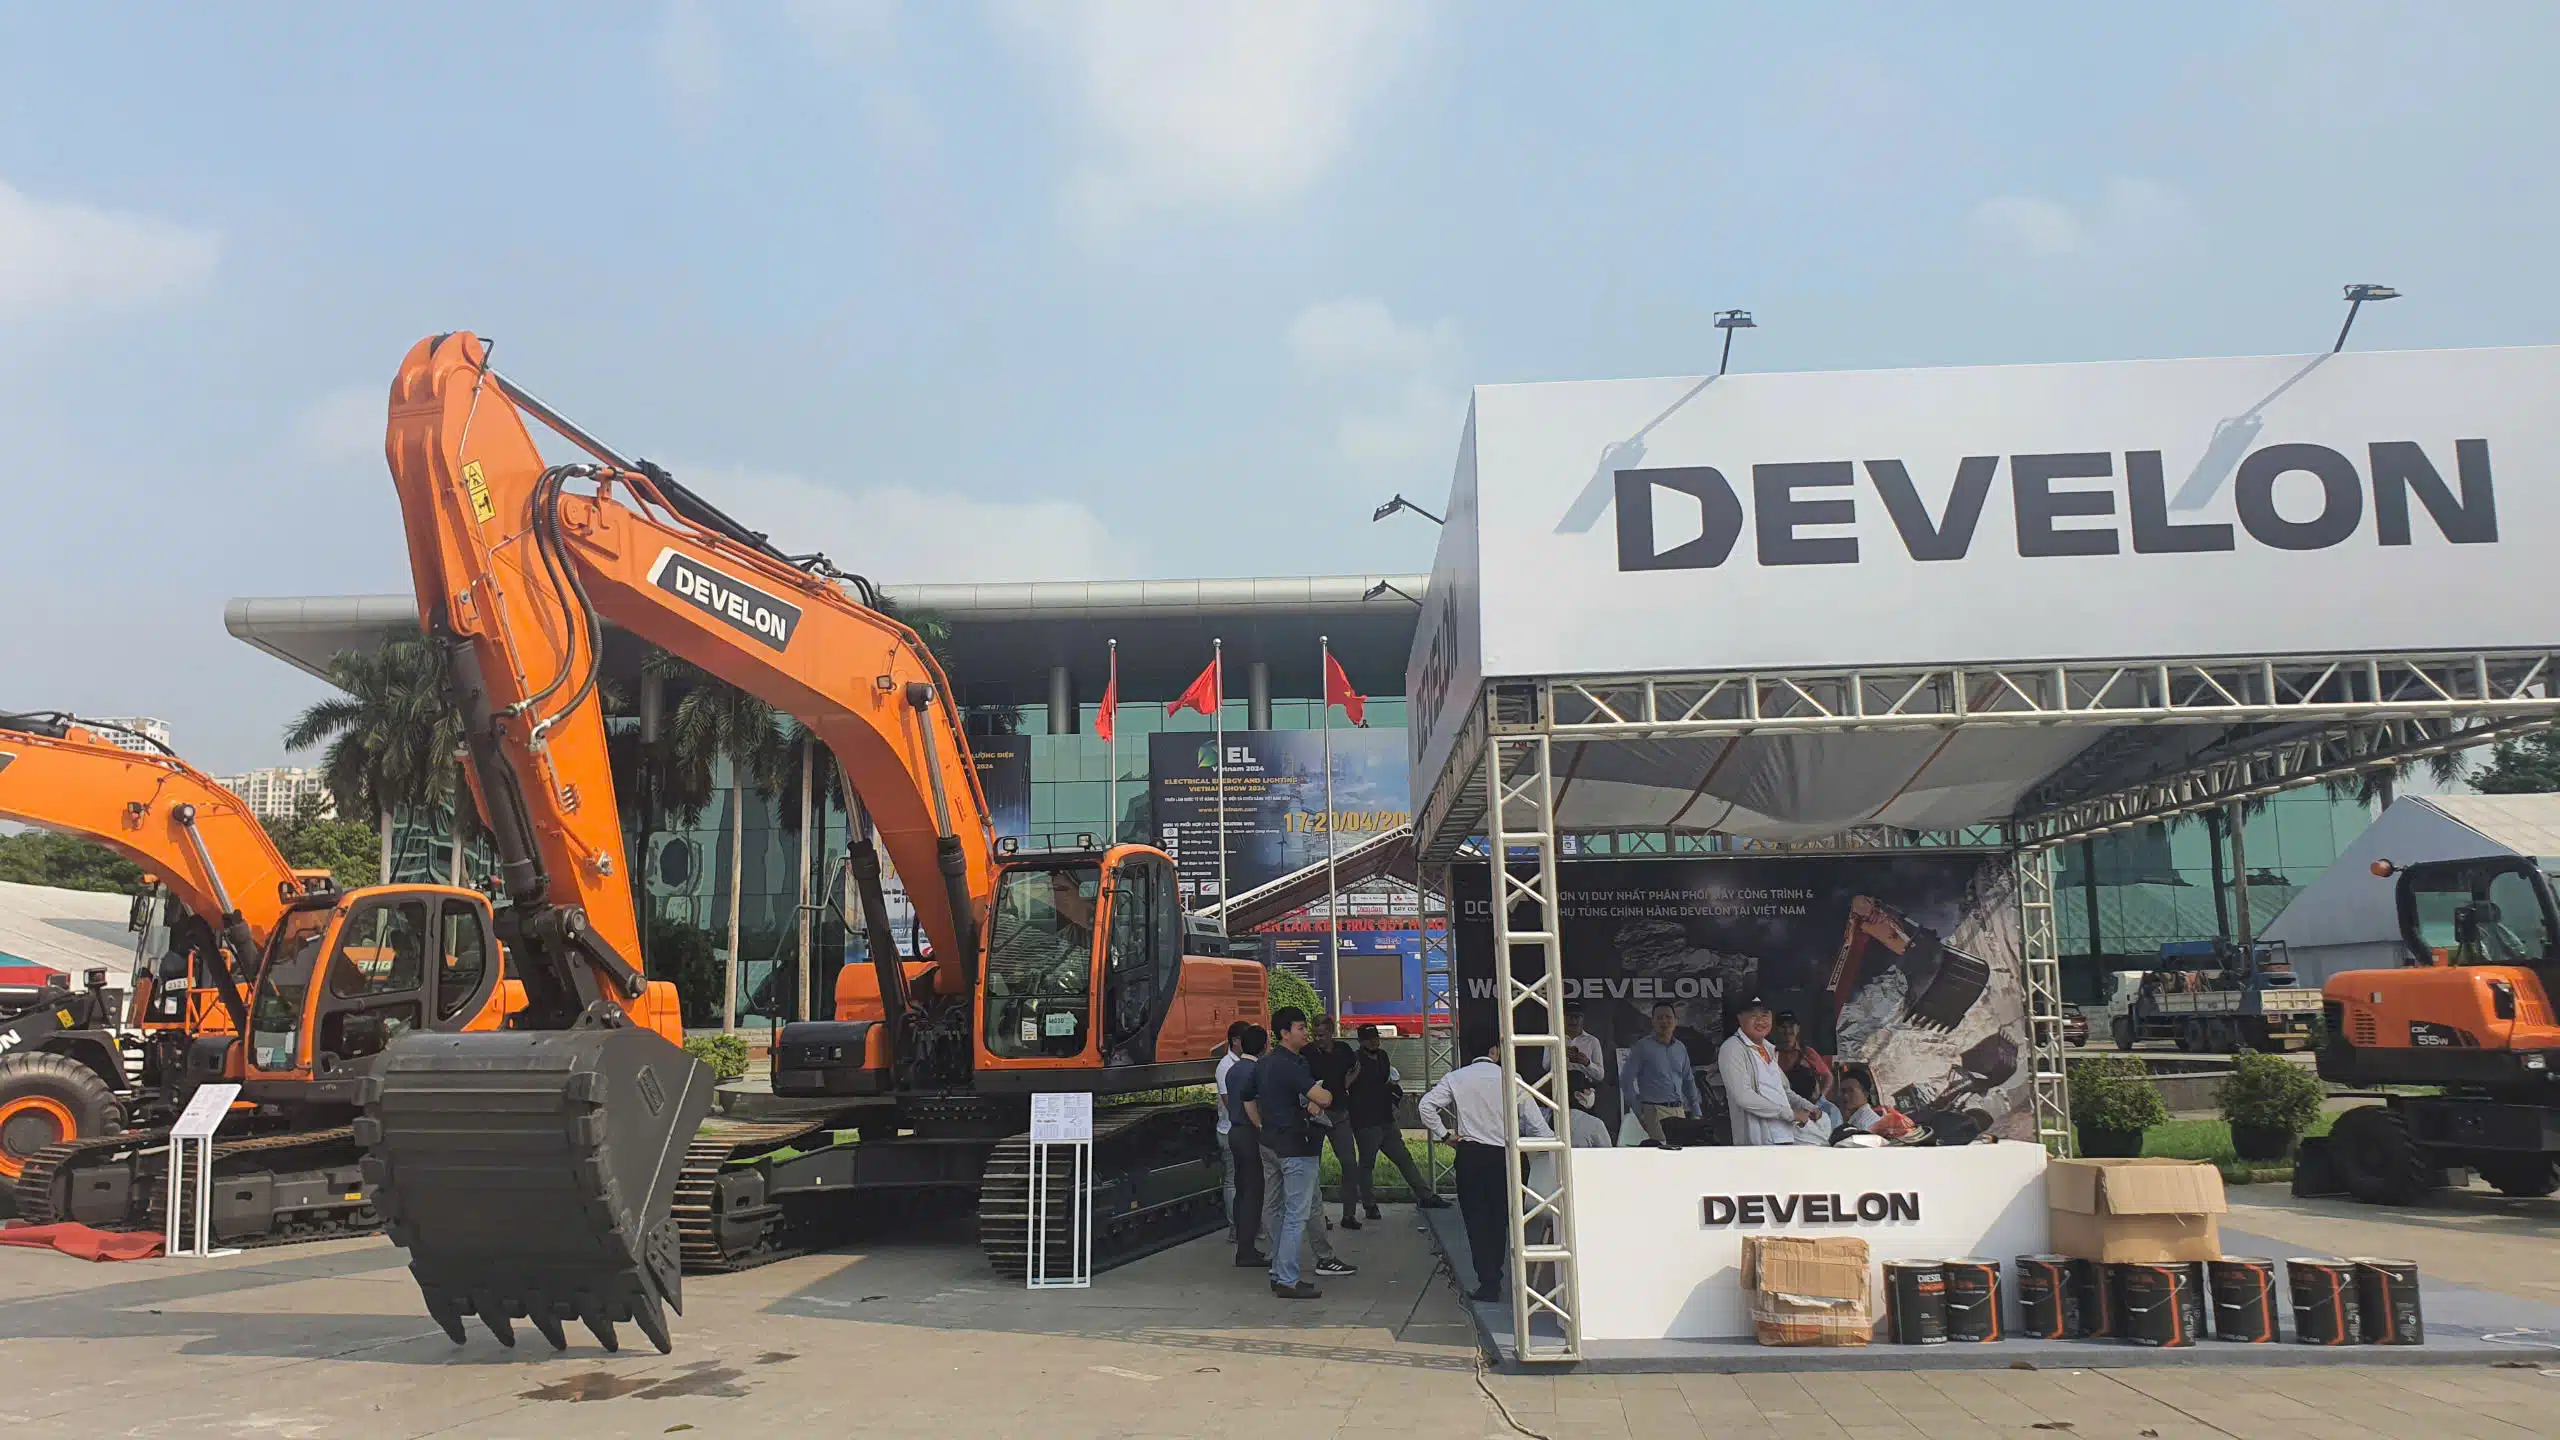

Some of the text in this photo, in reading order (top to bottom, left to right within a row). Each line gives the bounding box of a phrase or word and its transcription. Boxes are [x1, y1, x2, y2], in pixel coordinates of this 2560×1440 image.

[1614, 439, 2499, 573] DEVELON
[674, 564, 788, 643] DEVELON
[1226, 746, 1257, 764] EL
[1577, 891, 1589, 903] VỊ
[1591, 891, 1614, 901] DUY
[1616, 887, 1647, 900] NHẤT
[1737, 886, 1768, 900] CÔNG
[1769, 886, 1804, 899] TRÌNH
[1805, 888, 1815, 899] &
[1610, 904, 1644, 917] CHÍNH
[1680, 905, 1731, 917] DEVELON
[1731, 905, 1750, 918] TẠI
[1751, 903, 1778, 918] VIỆT
[1779, 904, 1807, 916] NAM
[1561, 977, 1724, 1000] DEVELON
[1702, 1191, 1921, 1225] DEVELON
